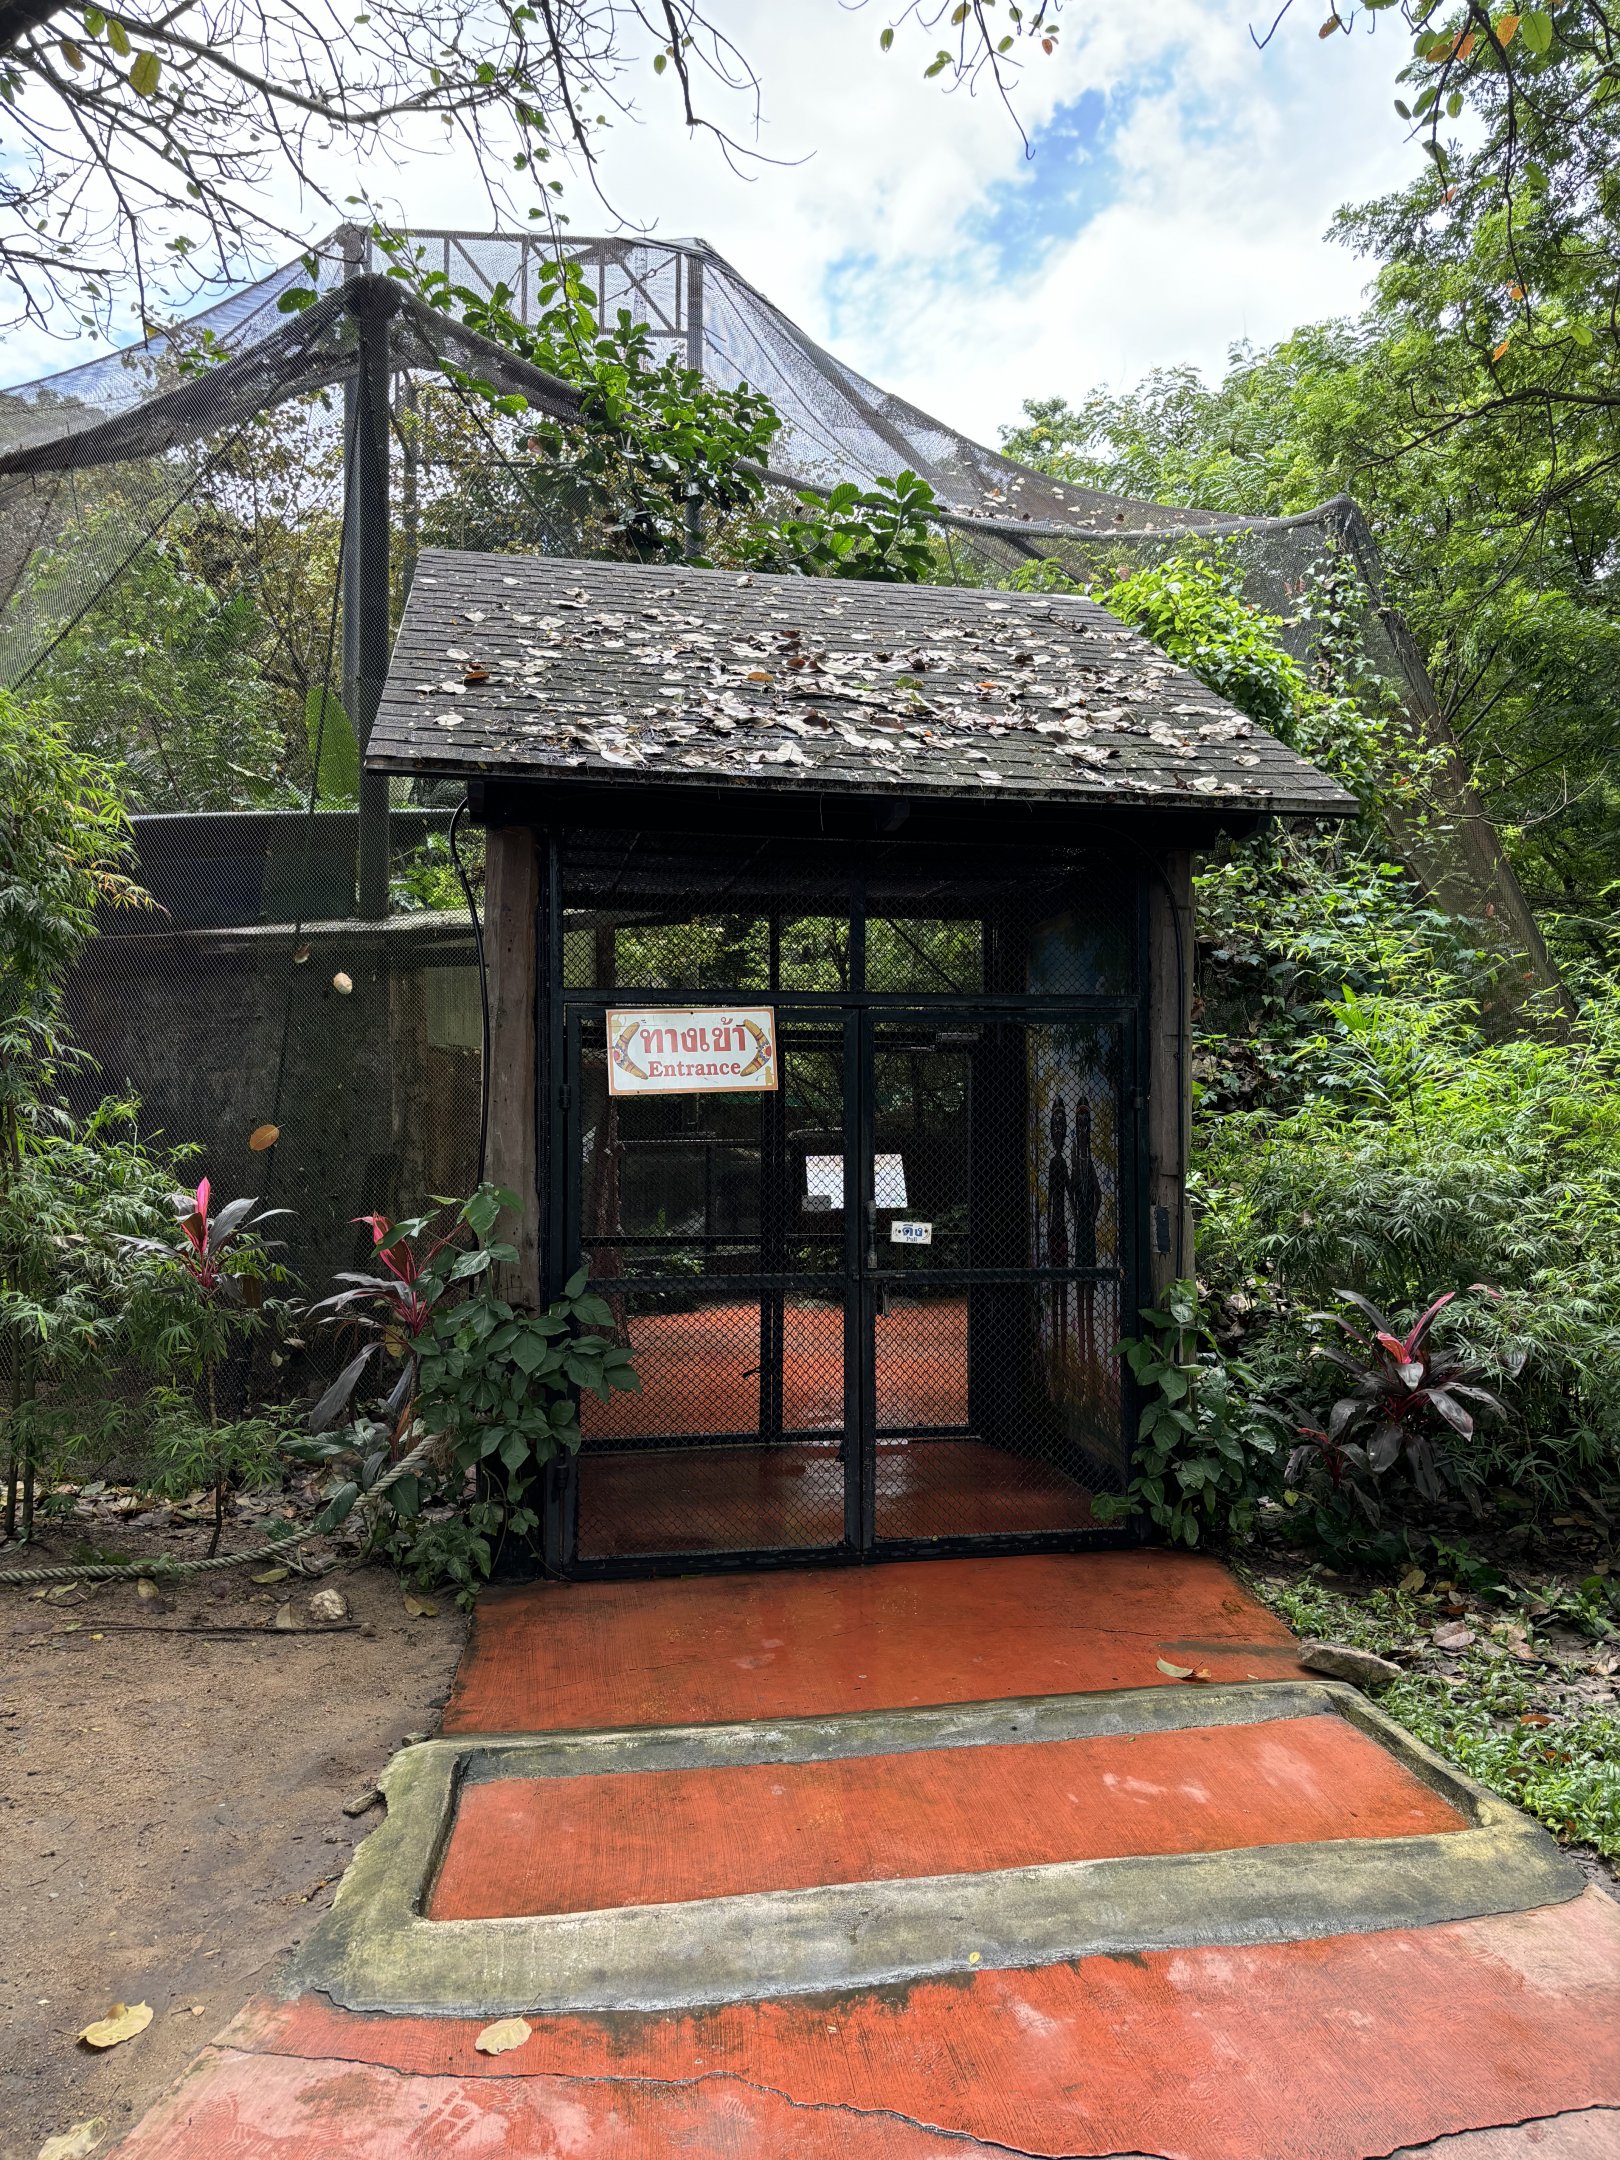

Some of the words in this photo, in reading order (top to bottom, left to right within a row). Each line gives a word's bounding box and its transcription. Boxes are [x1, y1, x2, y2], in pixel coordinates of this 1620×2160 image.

[640, 1017, 746, 1053] ทางเข้า
[648, 1060, 741, 1078] Entrance
